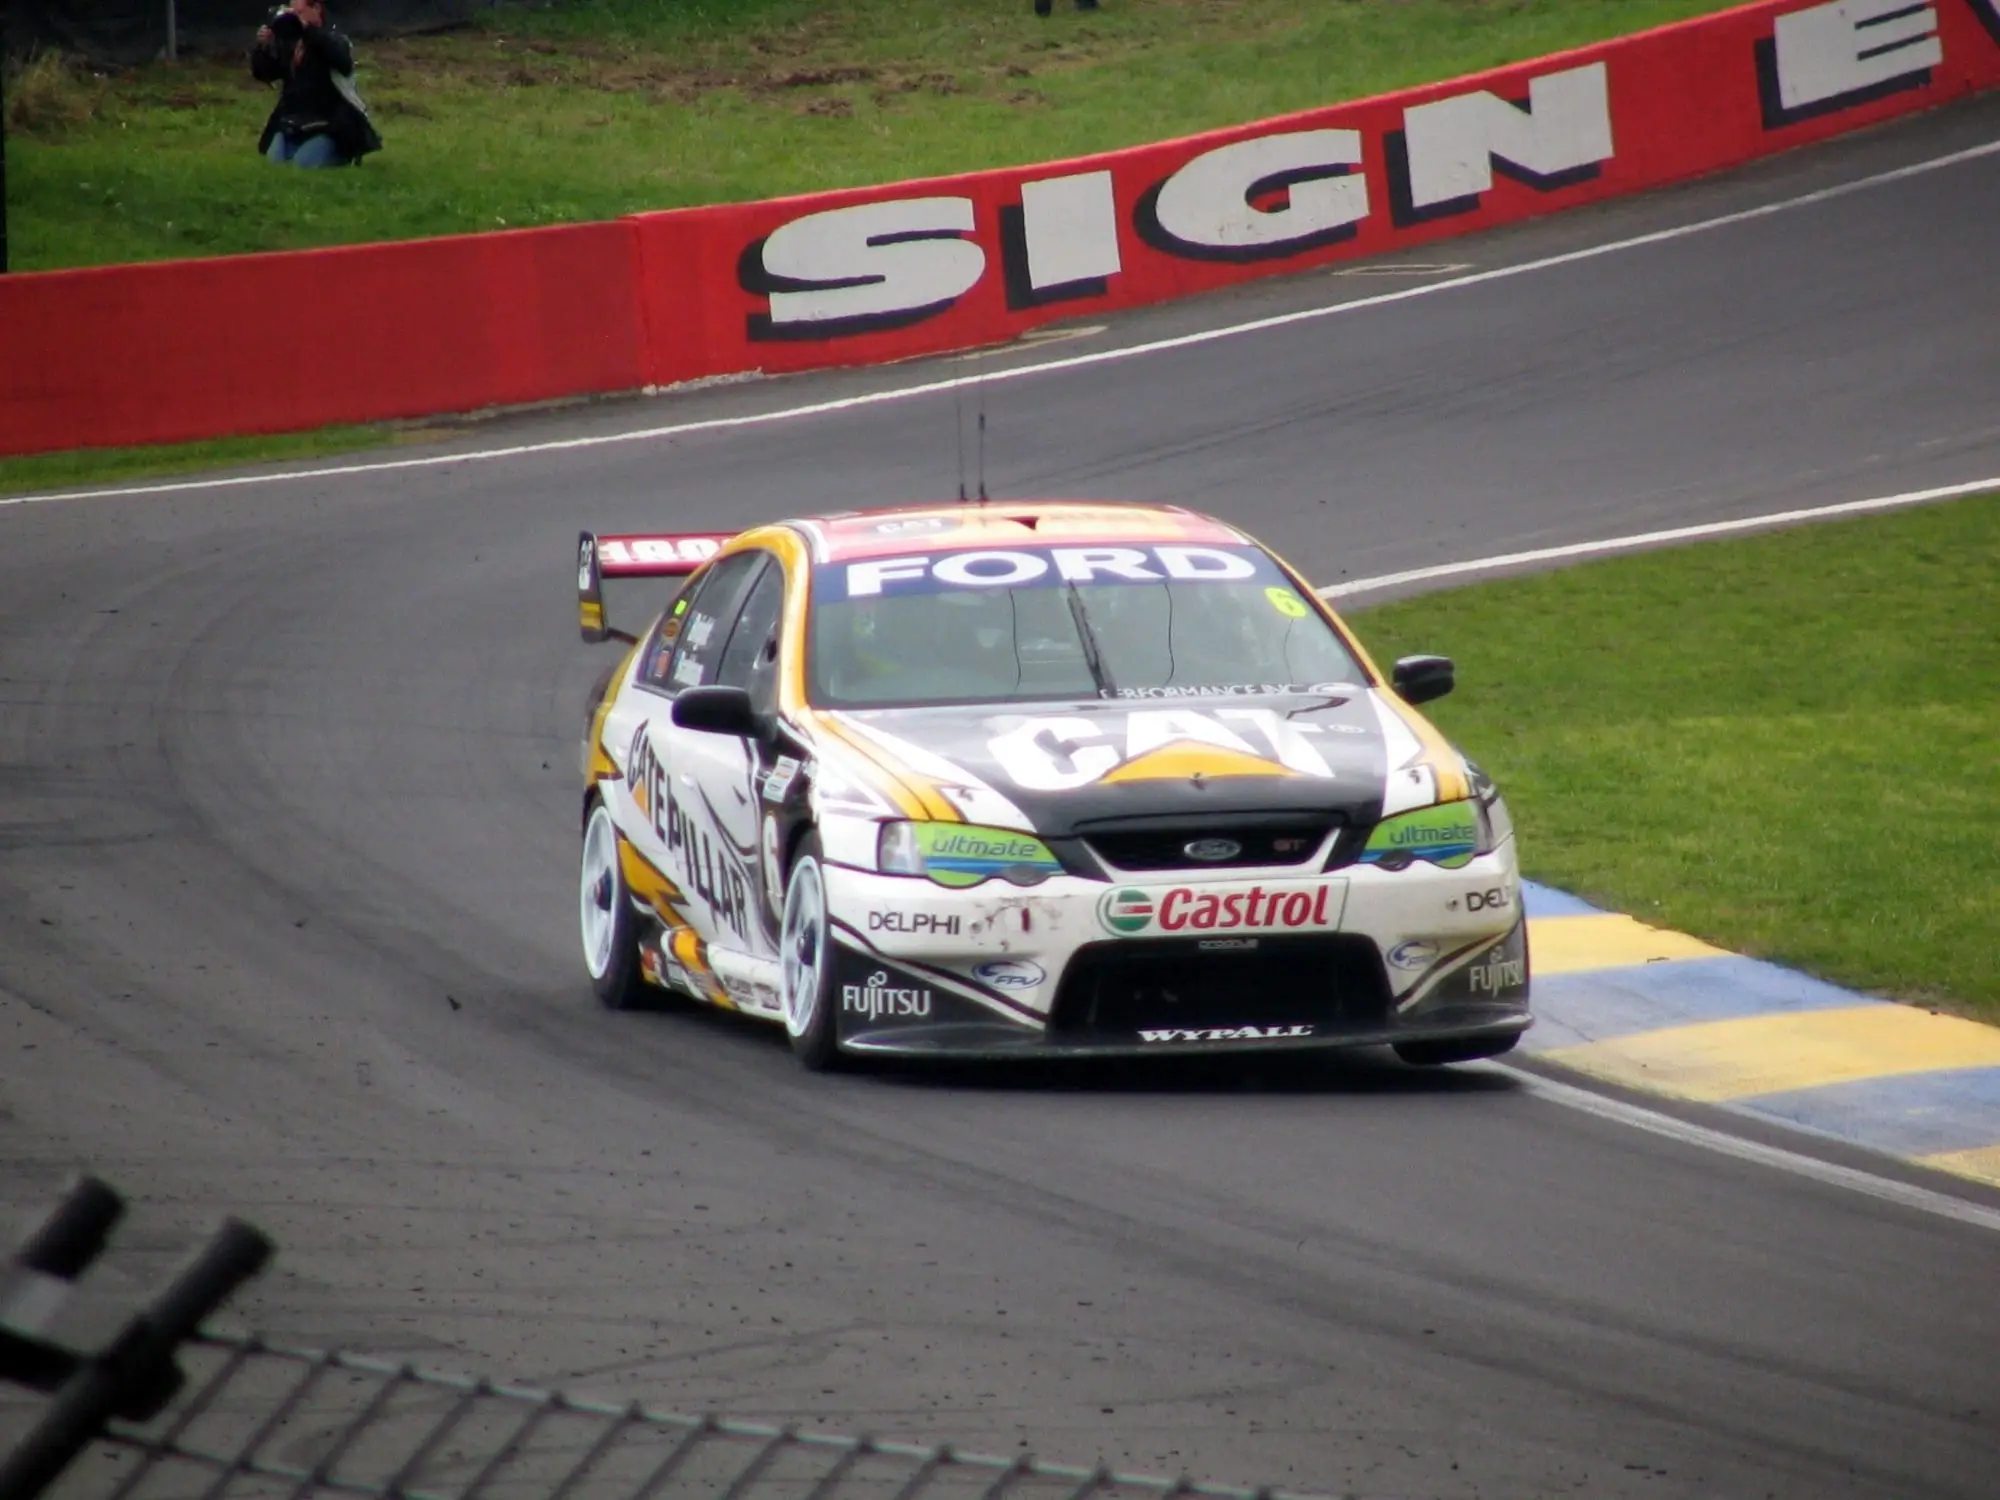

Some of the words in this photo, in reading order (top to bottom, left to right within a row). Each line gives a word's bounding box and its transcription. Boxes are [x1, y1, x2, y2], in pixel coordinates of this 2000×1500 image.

[740, 62, 1613, 341] SIGN
[1755, 0, 2000, 131] E
[847, 546, 1257, 597] FORD
[987, 709, 1335, 790] CAT
[627, 718, 748, 940] CATEPILLAR
[931, 834, 1037, 858] ultimate
[1389, 823, 1475, 844] ultimate
[1158, 884, 1328, 931] Castrol
[1465, 886, 1511, 912] DEL
[868, 911, 960, 935] DELPHI
[842, 984, 931, 1021] FUJITSU
[1137, 1026, 1315, 1042] WYPALL
